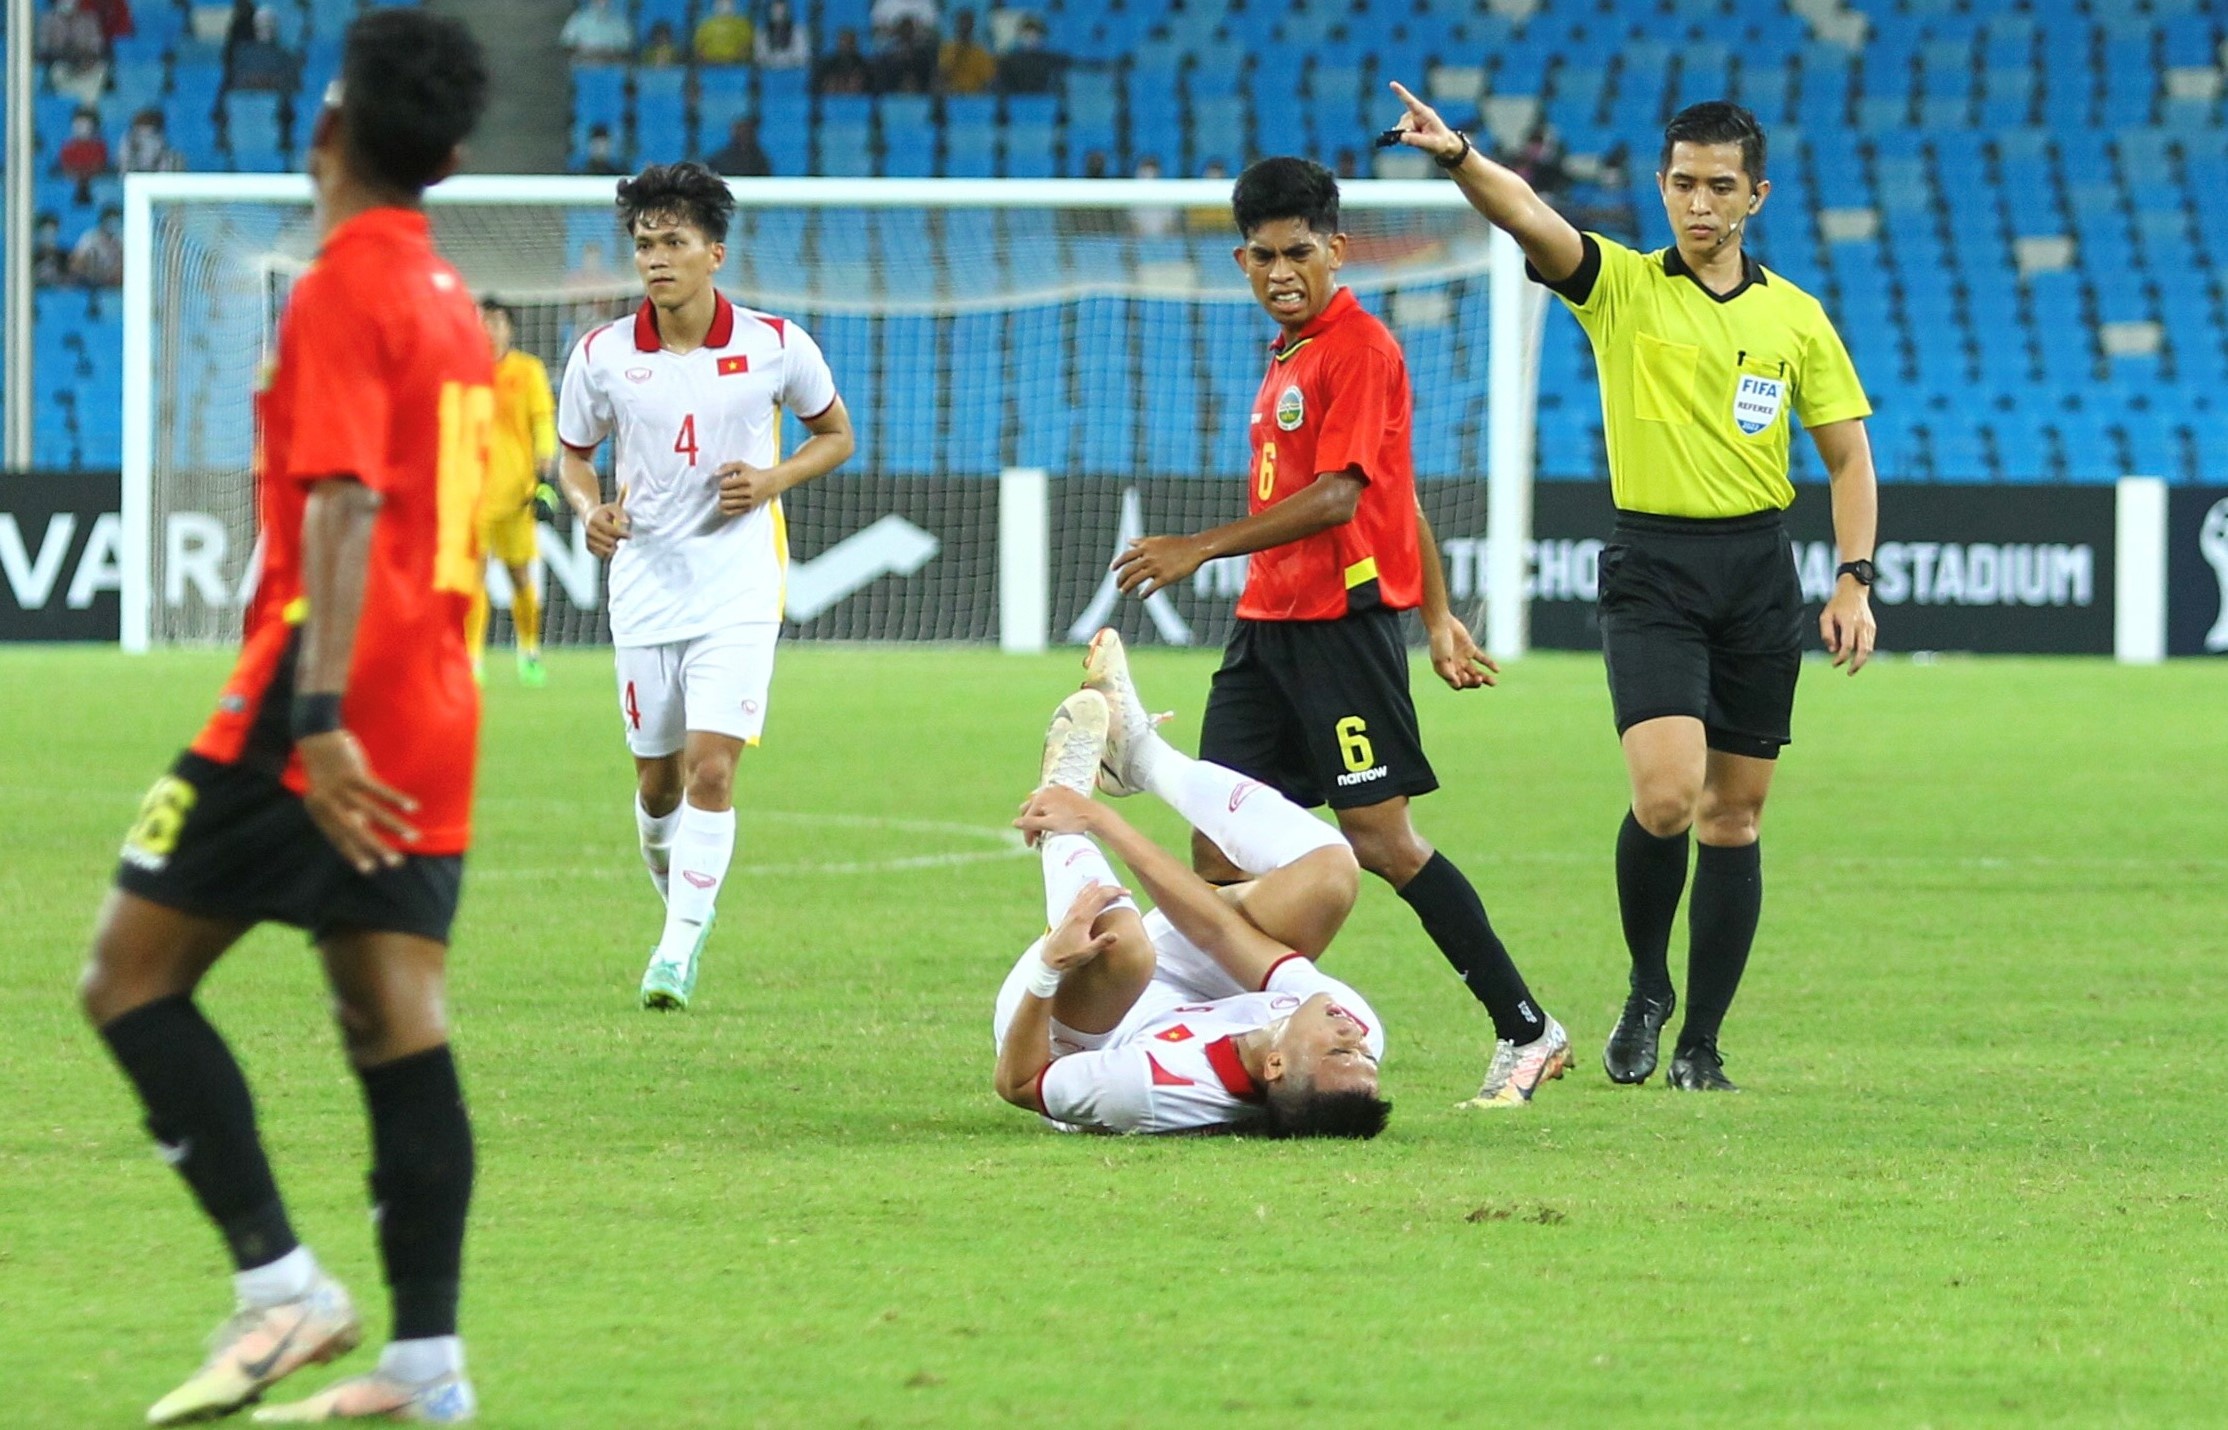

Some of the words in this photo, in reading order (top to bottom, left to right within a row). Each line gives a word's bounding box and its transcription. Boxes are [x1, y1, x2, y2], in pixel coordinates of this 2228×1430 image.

[1737, 401, 1774, 415] REFEREE
[1742, 379, 1777, 397] FIFA
[674, 413, 699, 467] 4
[1258, 441, 1276, 500] 6
[1874, 541, 2095, 607] STADIUM
[625, 680, 642, 730] 4
[1335, 715, 1375, 773] 6
[1336, 765, 1388, 787] narrow
